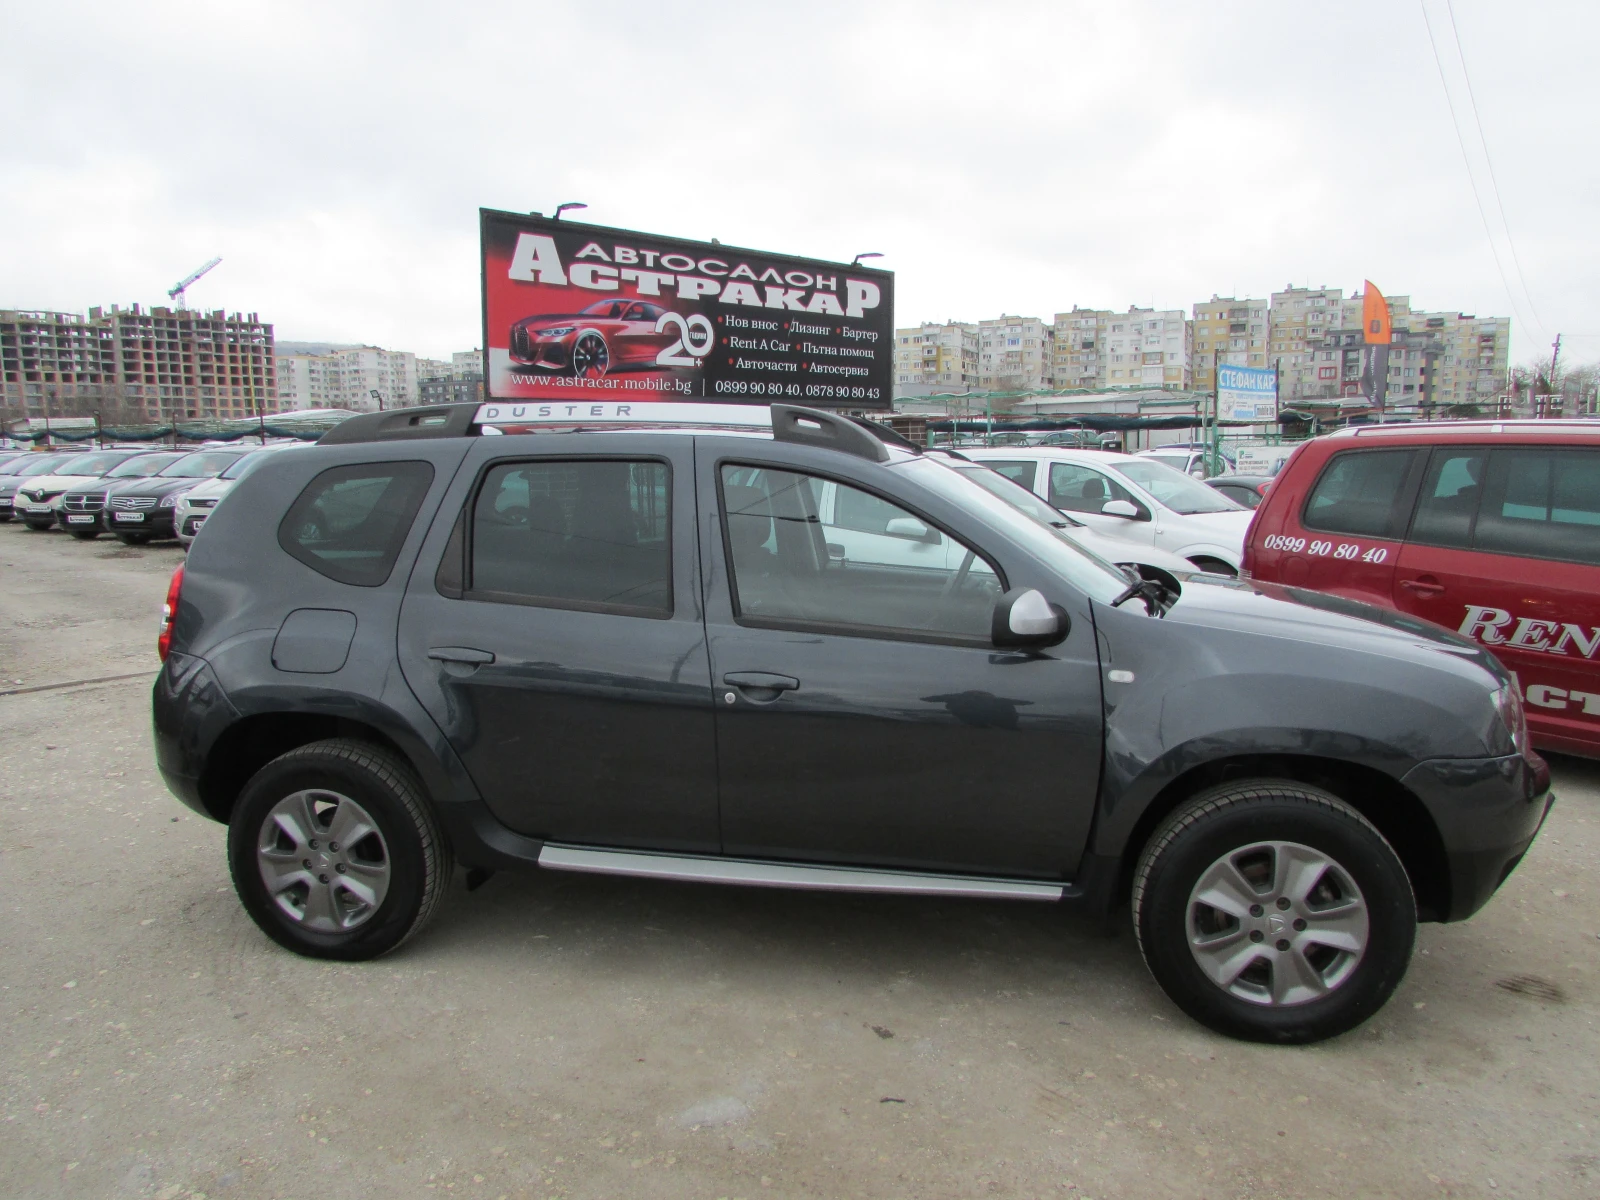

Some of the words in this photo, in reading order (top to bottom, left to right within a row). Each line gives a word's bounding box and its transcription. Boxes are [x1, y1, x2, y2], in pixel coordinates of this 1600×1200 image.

[508, 232, 880, 318] АСТРАКАР
[575, 242, 837, 291] АВТОСАЛОН
[725, 315, 749, 328] Нов
[752, 319, 778, 331] внос
[790, 320, 831, 336] Лизинг
[842, 326, 879, 342] Бартер
[730, 336, 757, 350] Rent
[759, 338, 768, 351] A
[770, 339, 791, 352] Car
[803, 342, 837, 356] Пътна
[839, 347, 875, 359] помощ
[735, 357, 798, 372] Авточасти
[809, 362, 869, 377] Автосервиз
[511, 373, 692, 395] www.astracar.mobile.bg
[1219, 369, 1257, 389] СТЕФАН
[1257, 374, 1275, 389] КАР
[715, 380, 748, 394] 0899
[750, 381, 765, 395] 90
[767, 382, 783, 395] 80
[805, 385, 834, 397] 0878
[836, 386, 850, 398] 90
[851, 387, 865, 398] 80
[866, 387, 880, 399] 43
[486, 405, 632, 418] DUSTER
[1264, 533, 1305, 553] 0899
[1307, 540, 1332, 556] 90
[1333, 543, 1358, 560] 80
[1361, 547, 1388, 564] 40
